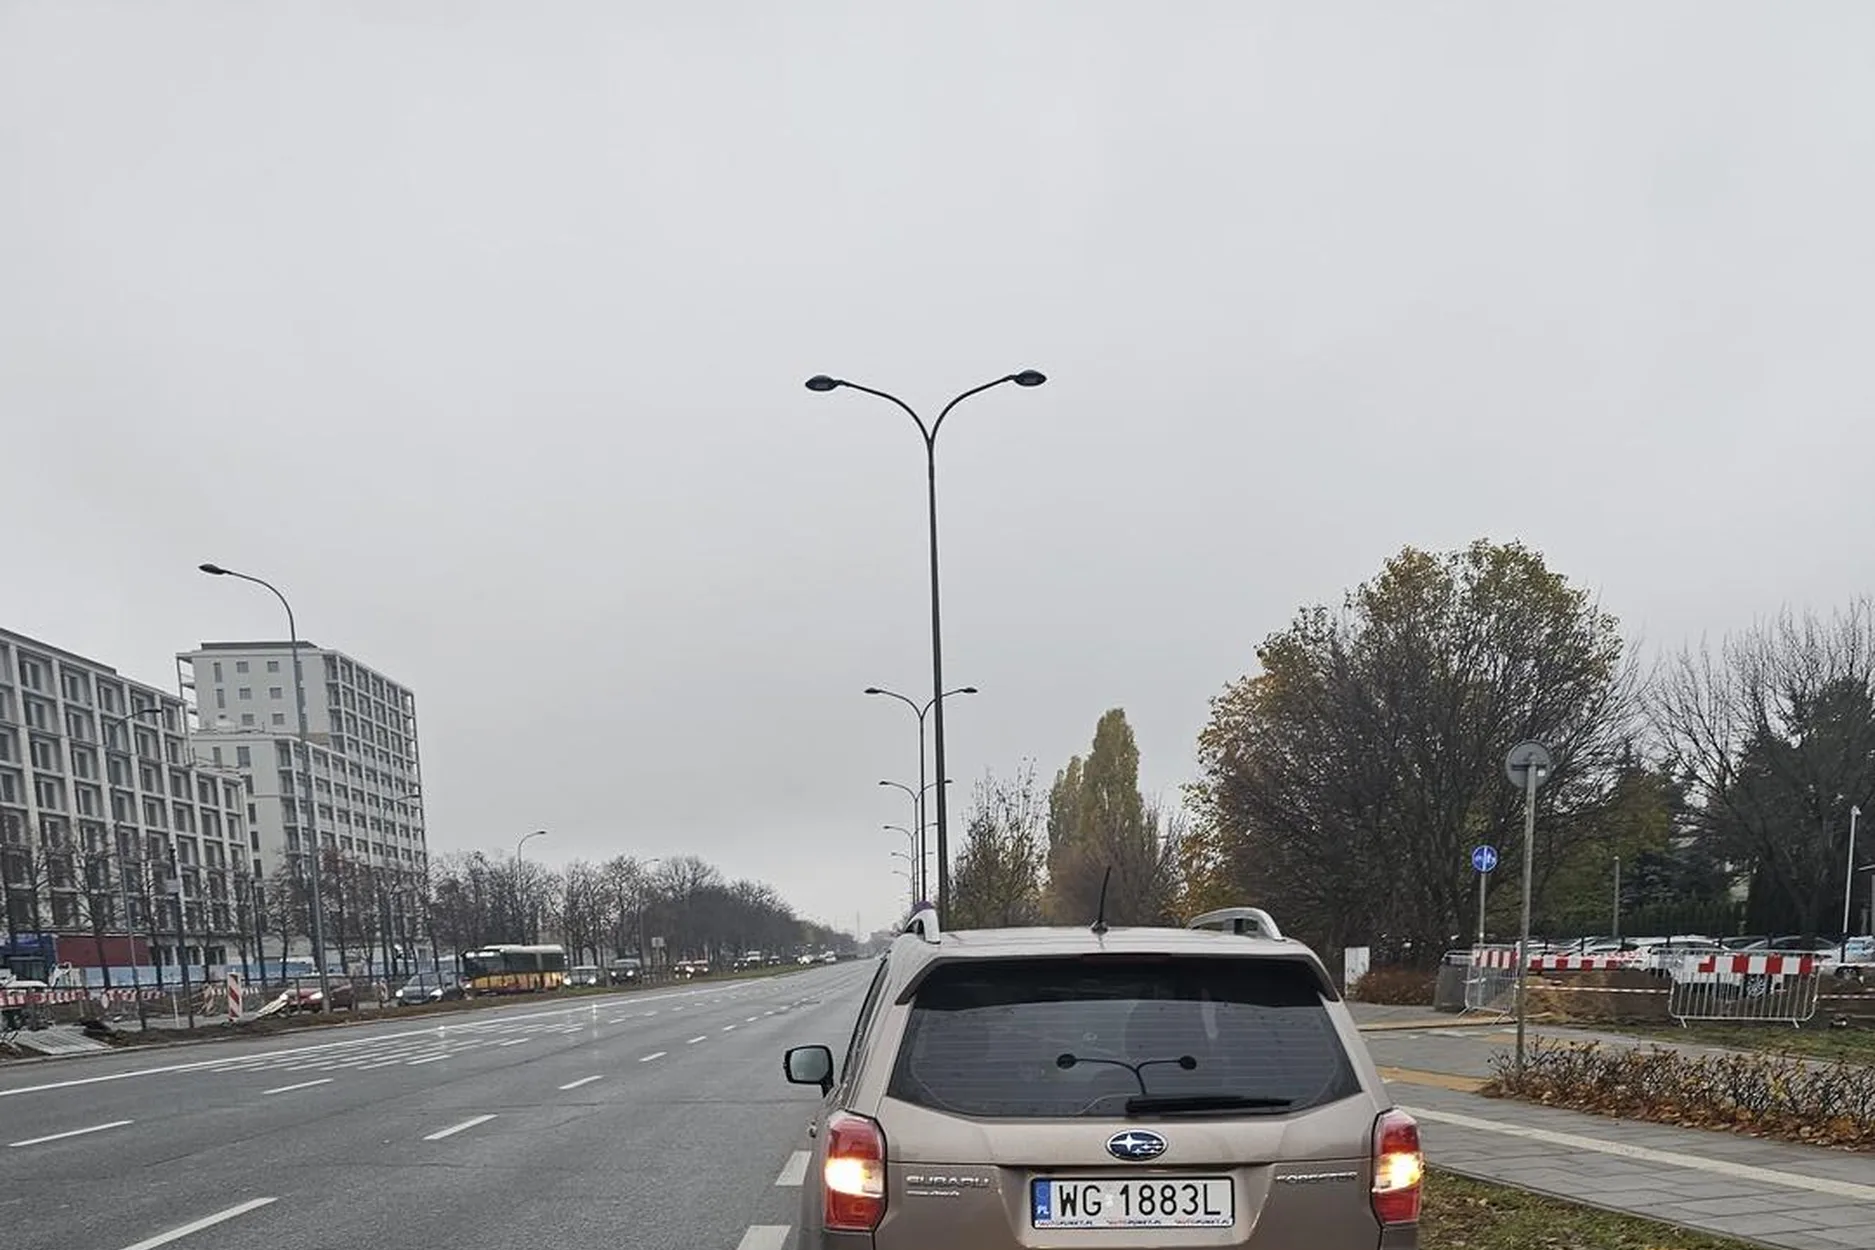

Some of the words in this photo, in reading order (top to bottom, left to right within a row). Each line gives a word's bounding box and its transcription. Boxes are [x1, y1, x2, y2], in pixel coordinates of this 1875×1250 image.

[906, 1175, 990, 1189] SUBARU
[1059, 1184, 1102, 1217] WG
[1119, 1183, 1222, 1216] 1883L
[1037, 1204, 1049, 1215] PL
